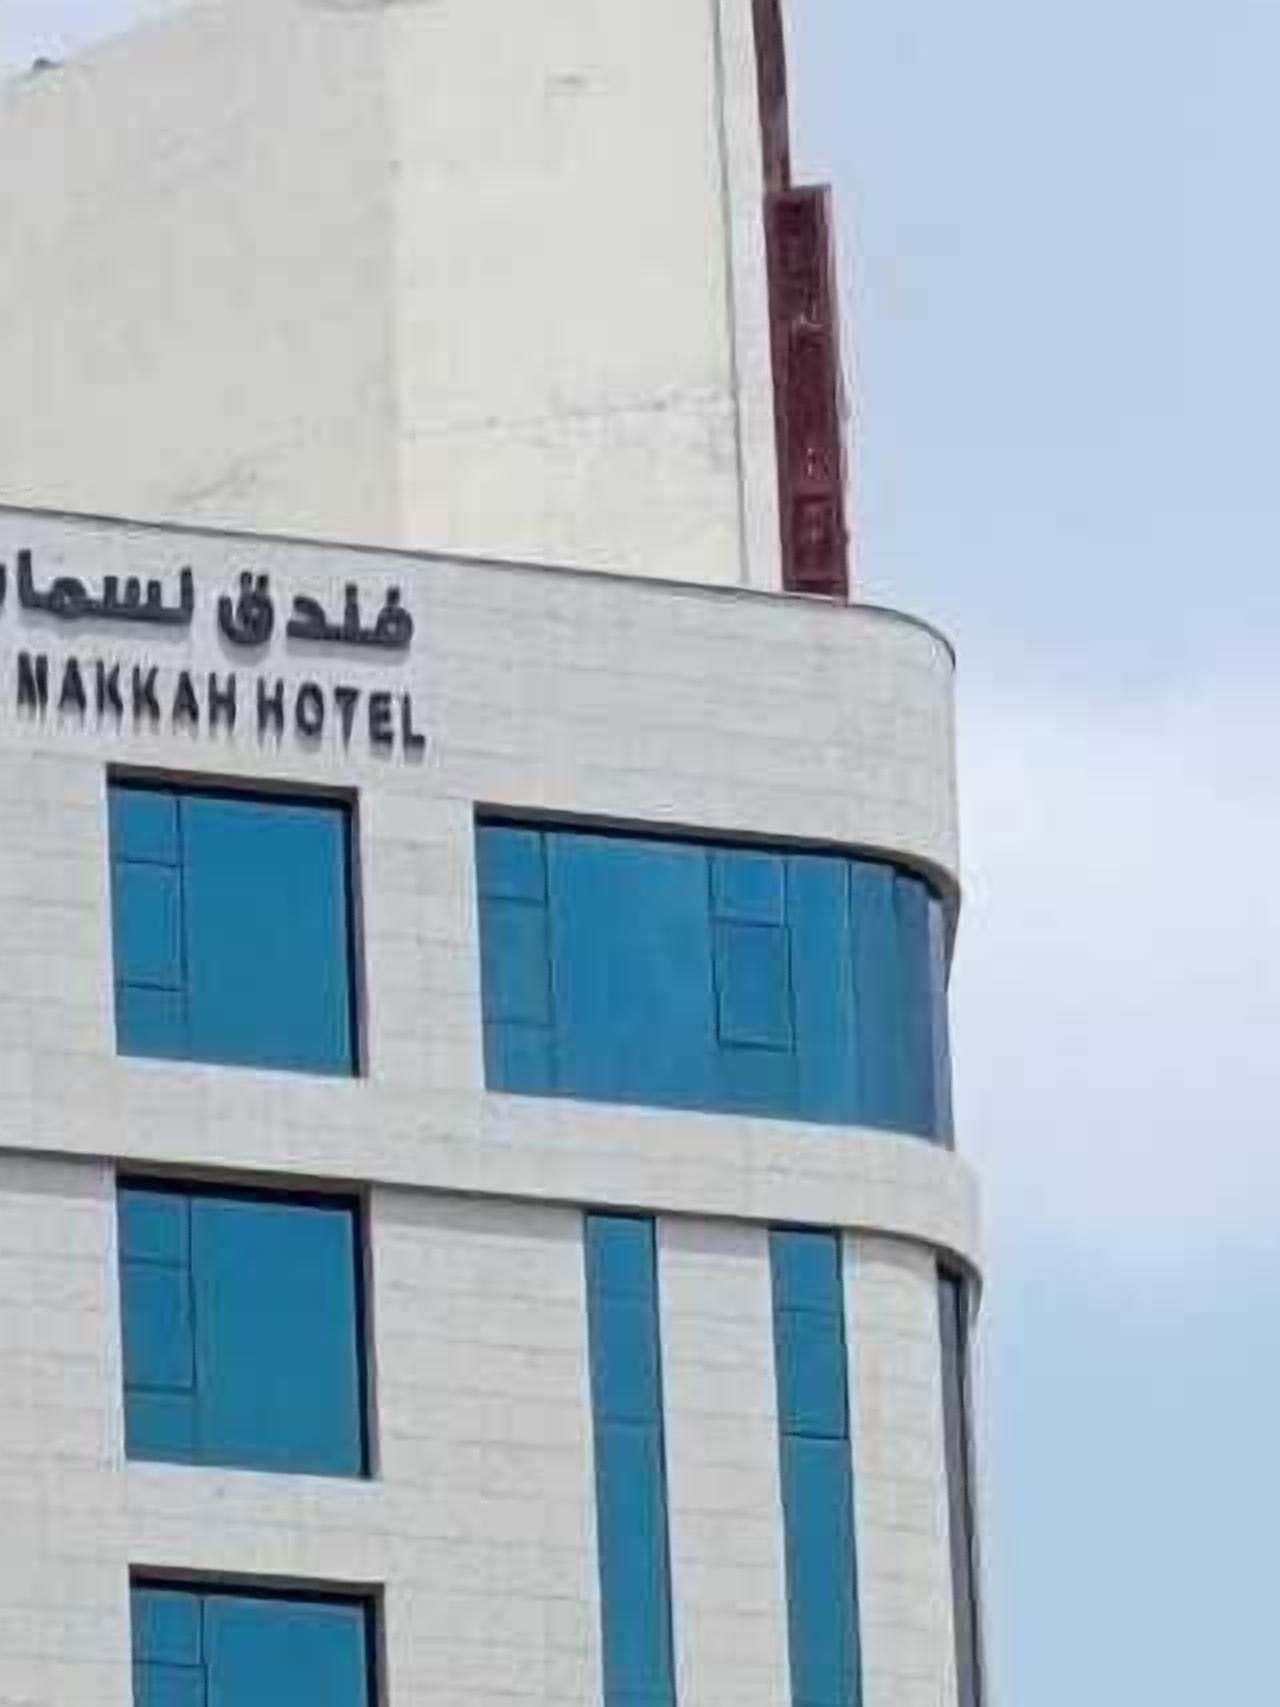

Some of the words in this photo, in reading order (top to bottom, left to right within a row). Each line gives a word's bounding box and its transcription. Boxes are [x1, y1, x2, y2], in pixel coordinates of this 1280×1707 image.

[217, 571, 414, 646] فندق
[17, 652, 236, 730] MAKKAH
[256, 674, 425, 750] HOTEL
